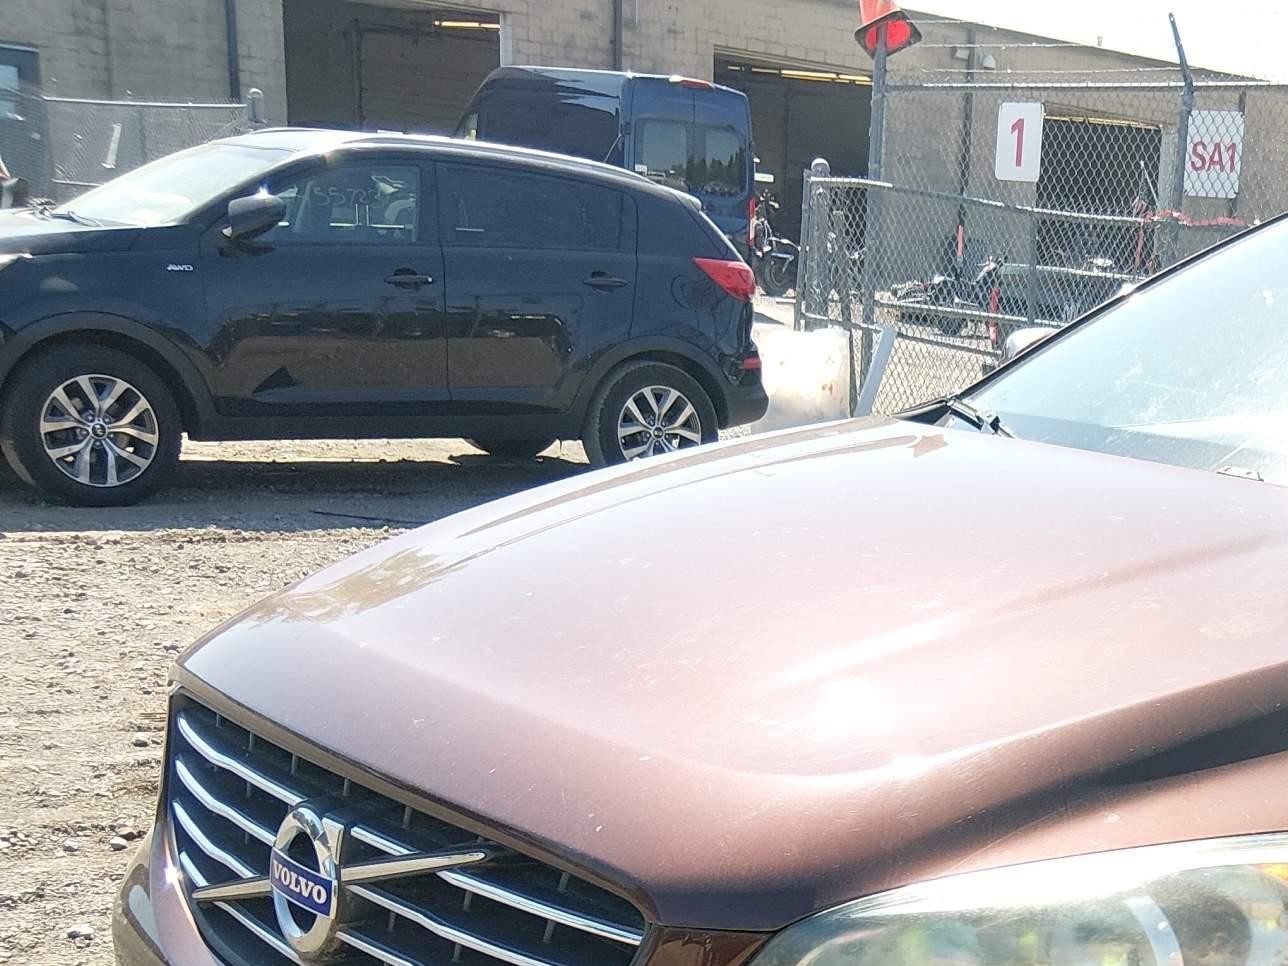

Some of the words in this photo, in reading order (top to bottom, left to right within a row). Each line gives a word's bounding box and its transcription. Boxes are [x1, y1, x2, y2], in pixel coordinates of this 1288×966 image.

[1011, 118, 1025, 168] 1
[1190, 140, 1237, 173] SA1
[273, 859, 327, 904] VOLVO
